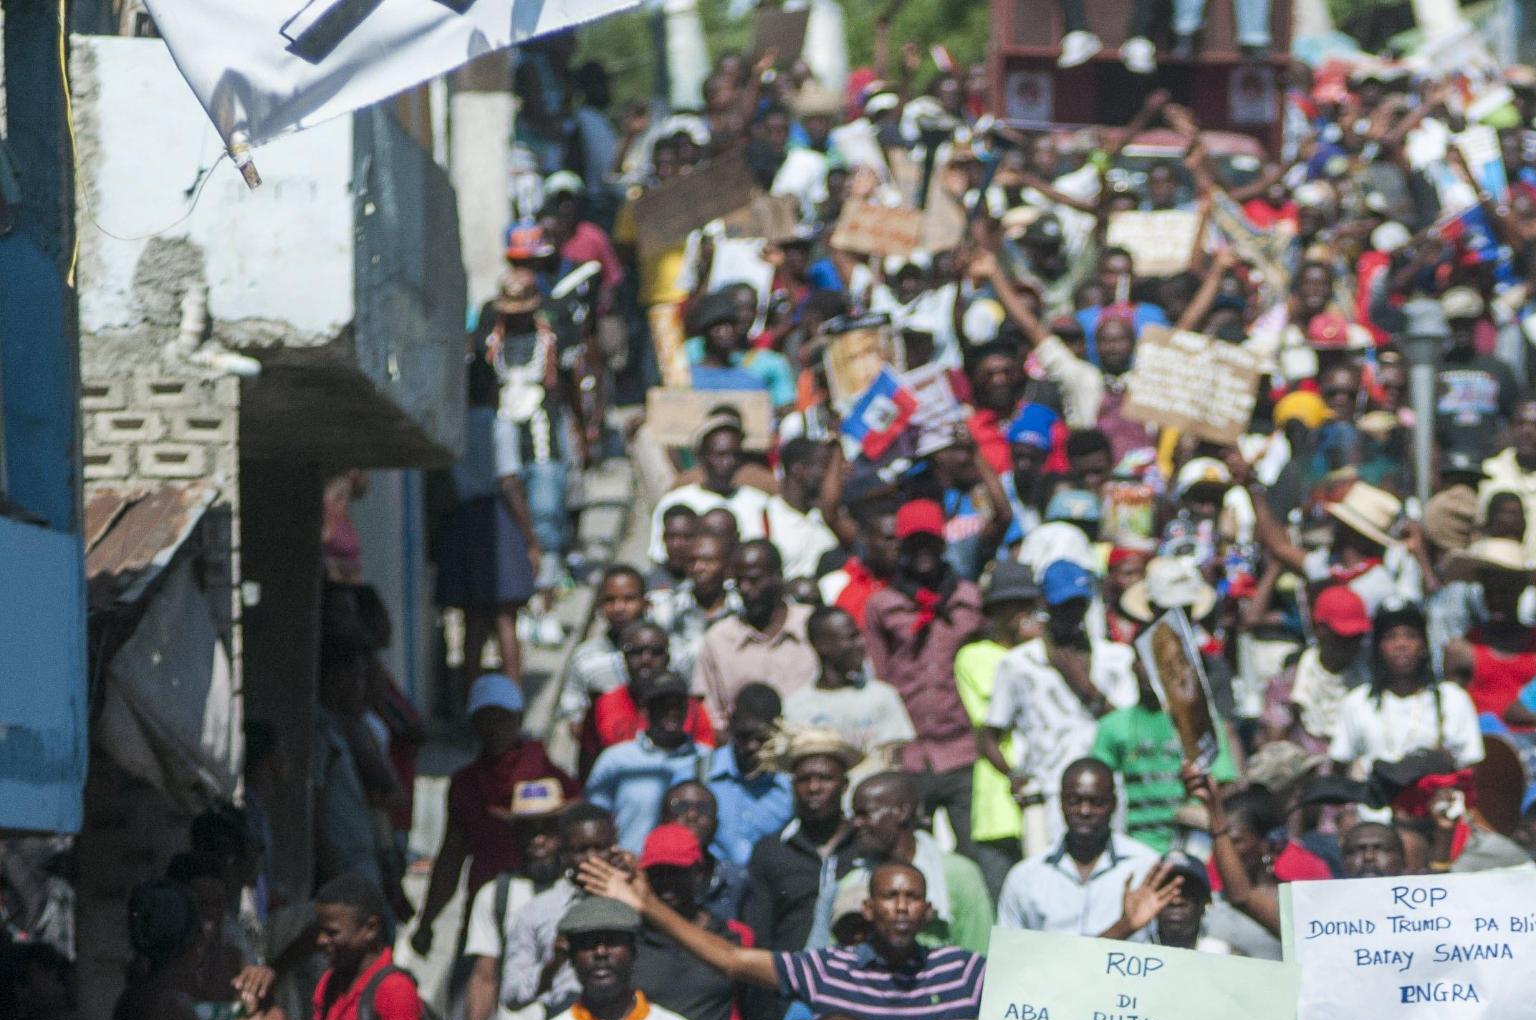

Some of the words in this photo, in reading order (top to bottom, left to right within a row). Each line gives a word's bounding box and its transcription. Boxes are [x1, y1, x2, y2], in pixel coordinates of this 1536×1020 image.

[1391, 886, 1447, 909] ROP
[1387, 915, 1452, 933] TRUMP
[1475, 917, 1499, 932] PA
[1433, 943, 1513, 963] SAVANA
[1106, 952, 1164, 977] ROP
[1116, 994, 1137, 1009] DI
